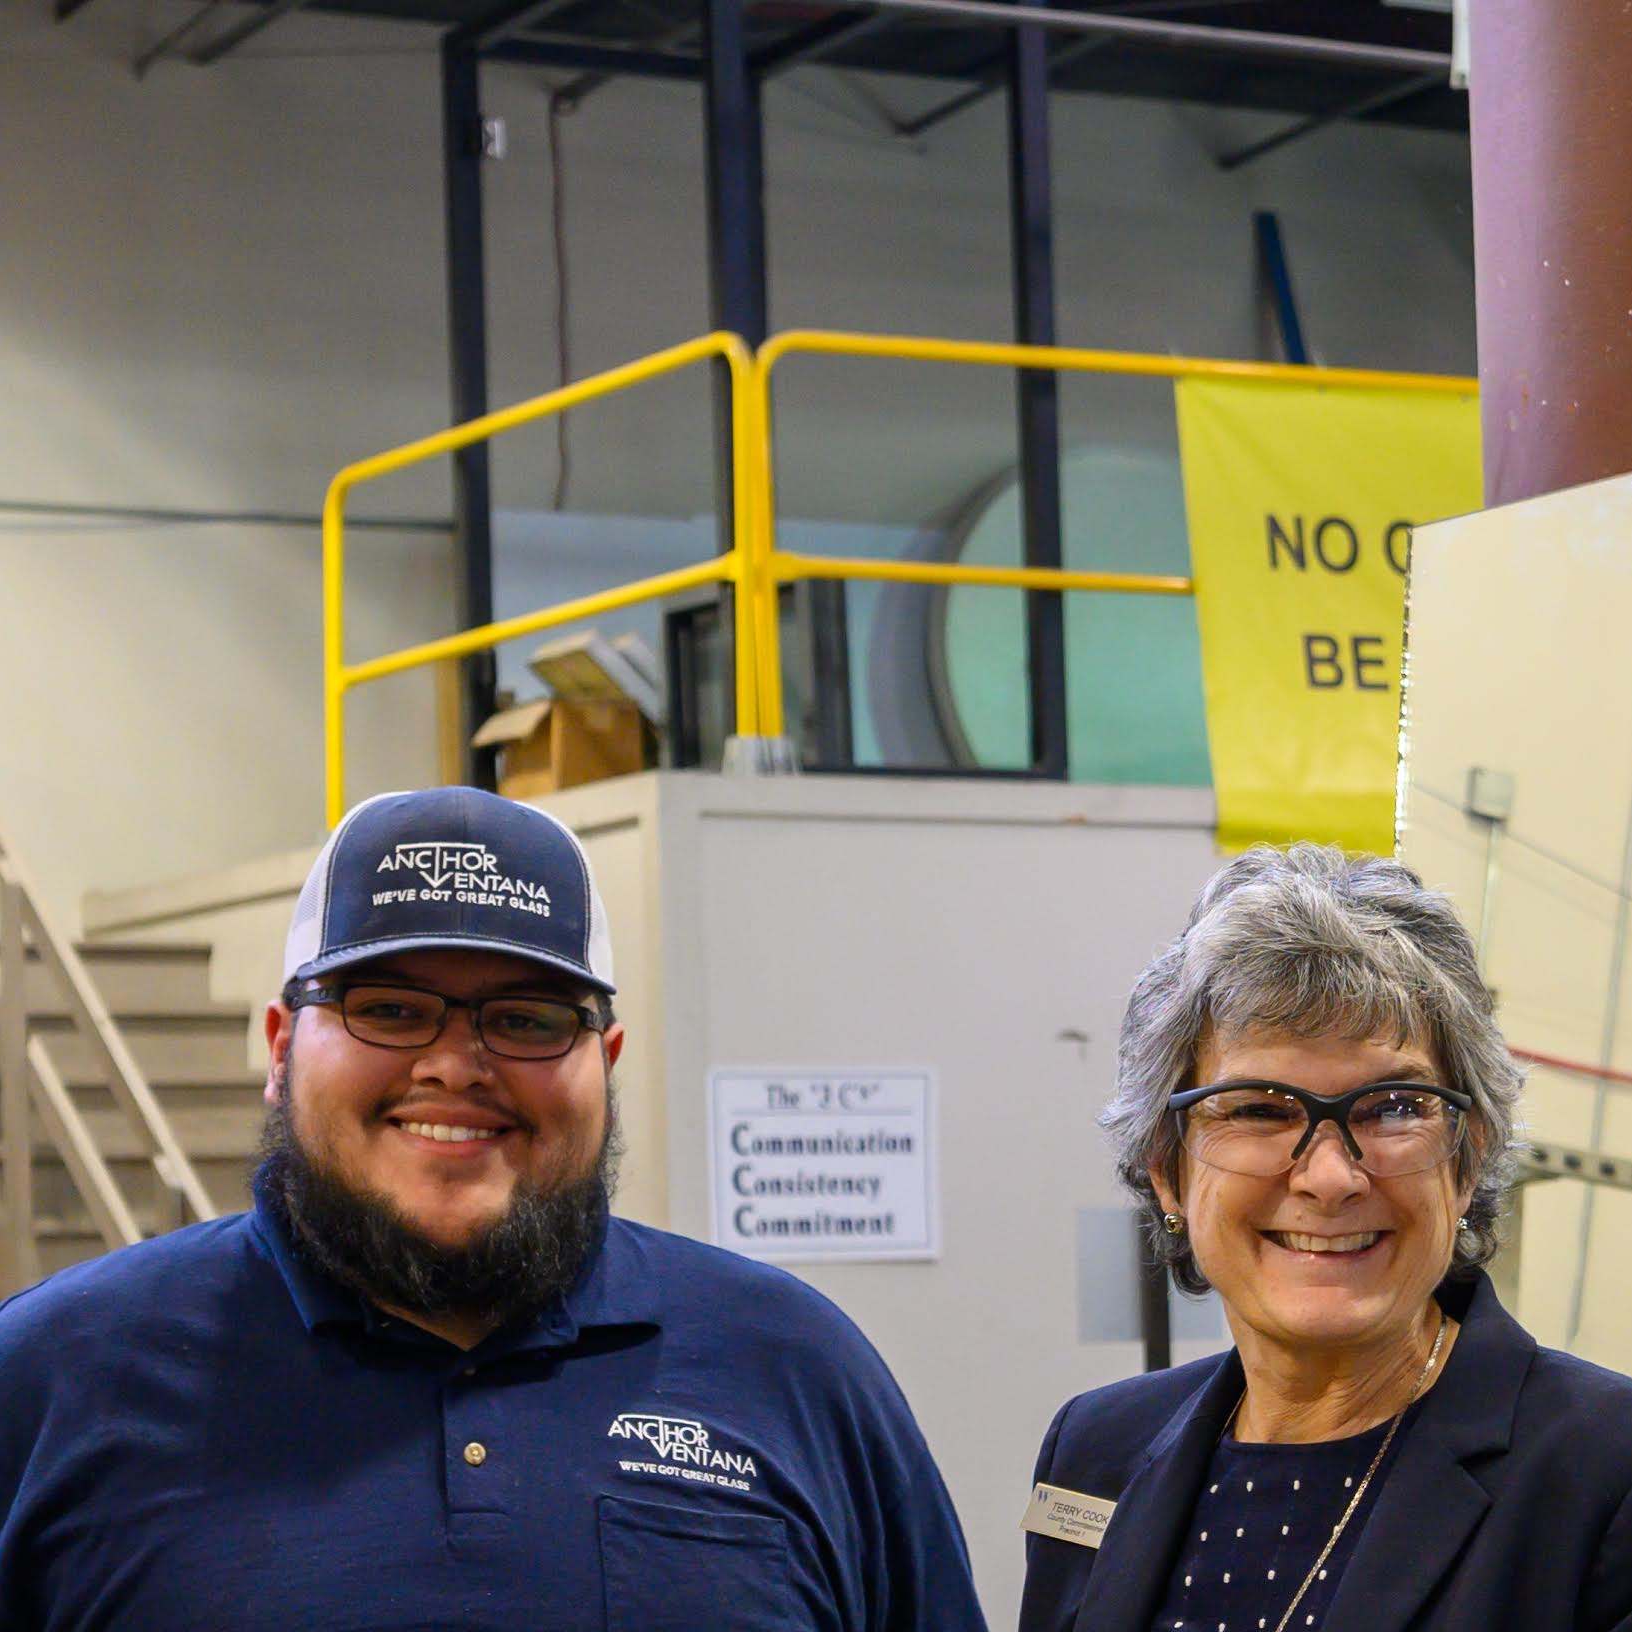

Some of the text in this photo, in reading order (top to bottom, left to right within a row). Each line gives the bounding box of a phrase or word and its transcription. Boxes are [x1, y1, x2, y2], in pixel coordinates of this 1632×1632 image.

[1266, 514, 1359, 574] NO
[1303, 634, 1390, 691] BE
[372, 889, 550, 918] WE'VE GOT GREAT GLASS
[730, 1121, 913, 1156] Communication
[731, 1164, 881, 1201] Consistency
[733, 1204, 895, 1238] Commitment
[618, 1460, 751, 1491] WE'VE GOT GREAT GLASS
[1052, 1502, 1110, 1525] TERRY COOK
